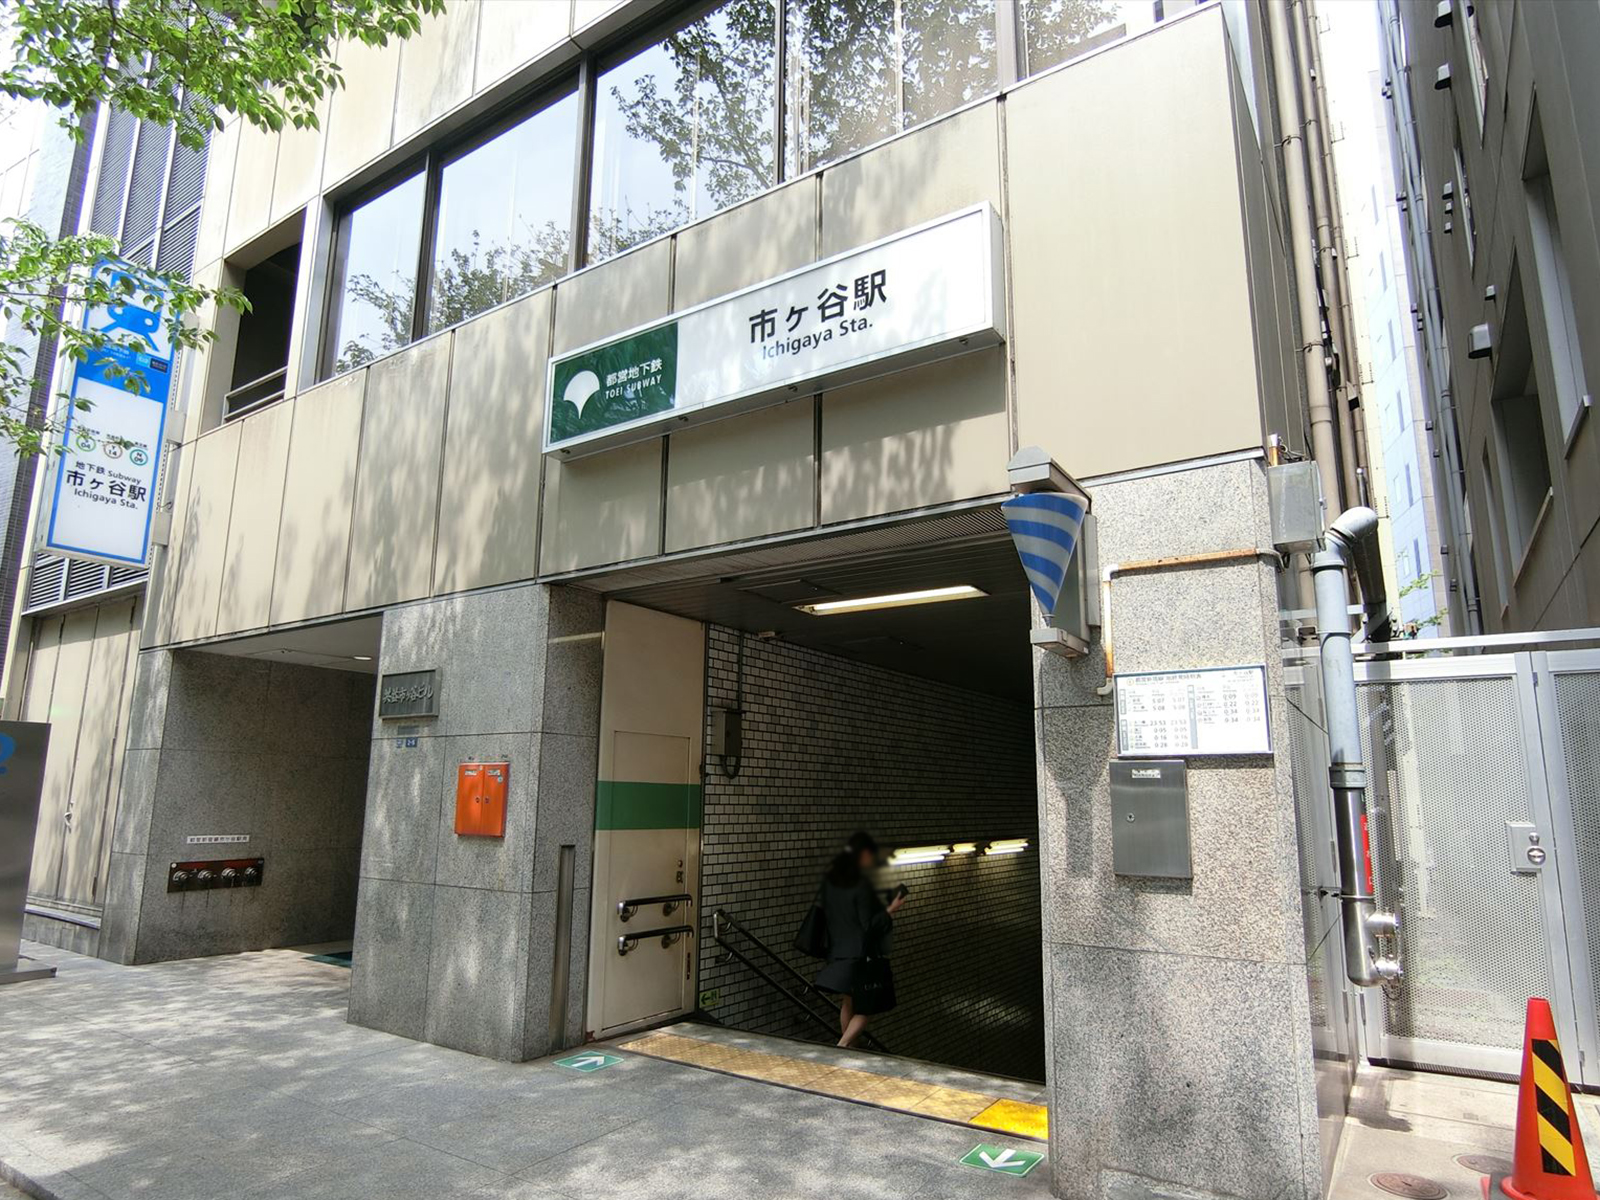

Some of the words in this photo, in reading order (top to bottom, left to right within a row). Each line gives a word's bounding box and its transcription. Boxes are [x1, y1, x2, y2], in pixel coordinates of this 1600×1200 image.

[762, 328, 833, 360] Ichigaya
[839, 317, 873, 337] Sta.
[606, 358, 662, 387] 都営地下鉄
[605, 387, 623, 399] TOEI
[626, 375, 662, 394] SUBWAY
[75, 461, 106, 475] 地下鉄
[108, 470, 141, 485] Subway
[74, 488, 117, 505] Ichigaya
[120, 498, 138, 510] Sta.
